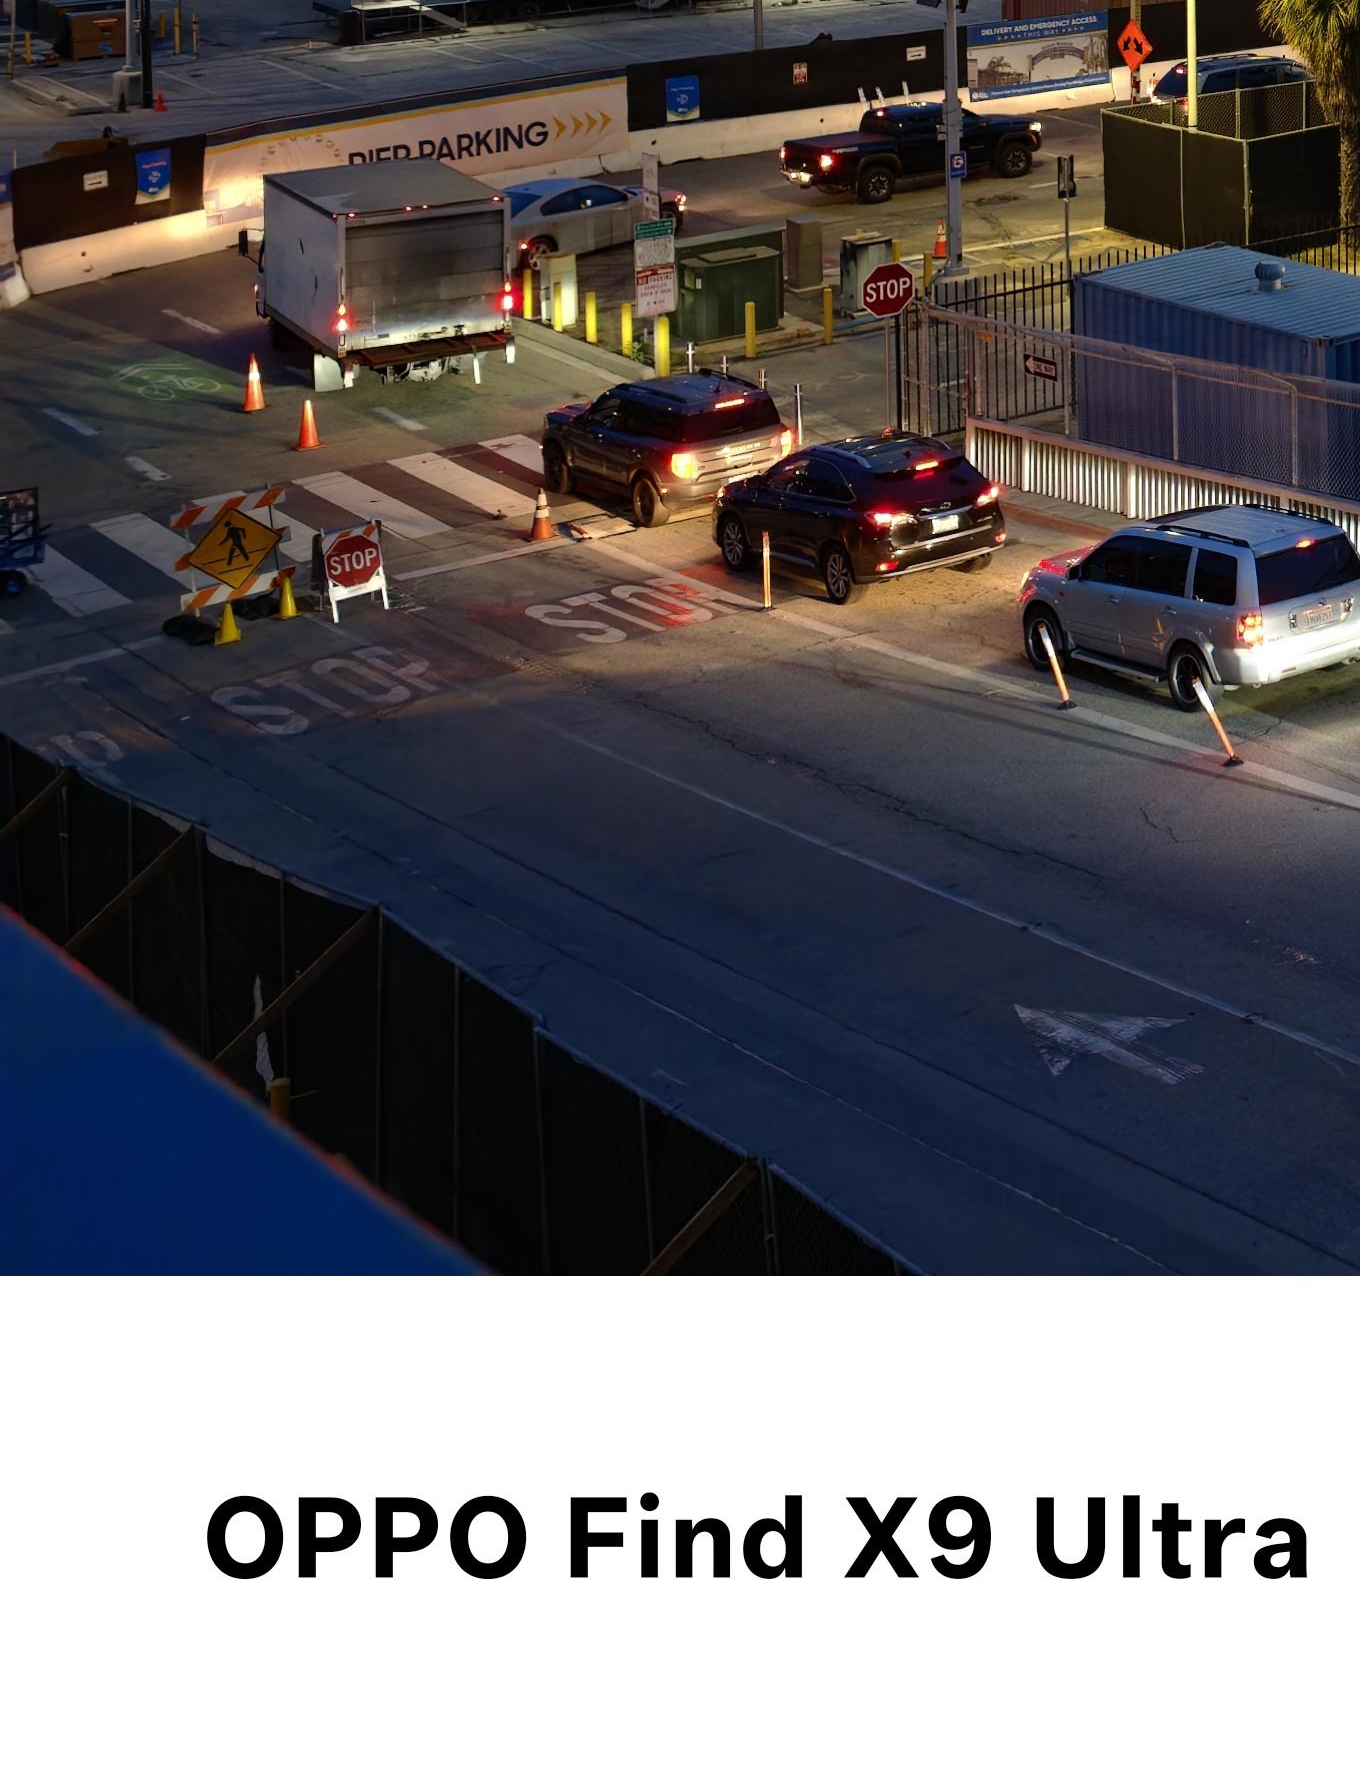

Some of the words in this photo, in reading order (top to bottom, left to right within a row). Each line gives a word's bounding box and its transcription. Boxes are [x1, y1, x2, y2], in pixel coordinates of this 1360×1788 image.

[981, 25, 1013, 36] DELIVERY
[1014, 24, 1029, 32] AND
[1029, 20, 1070, 31] EMERGENCY
[1071, 15, 1098, 25] ACCESS
[418, 121, 549, 161] PARKING
[865, 277, 911, 303] STOP
[330, 548, 377, 575] STOP
[525, 577, 742, 644] STOP
[211, 645, 439, 735] STOP
